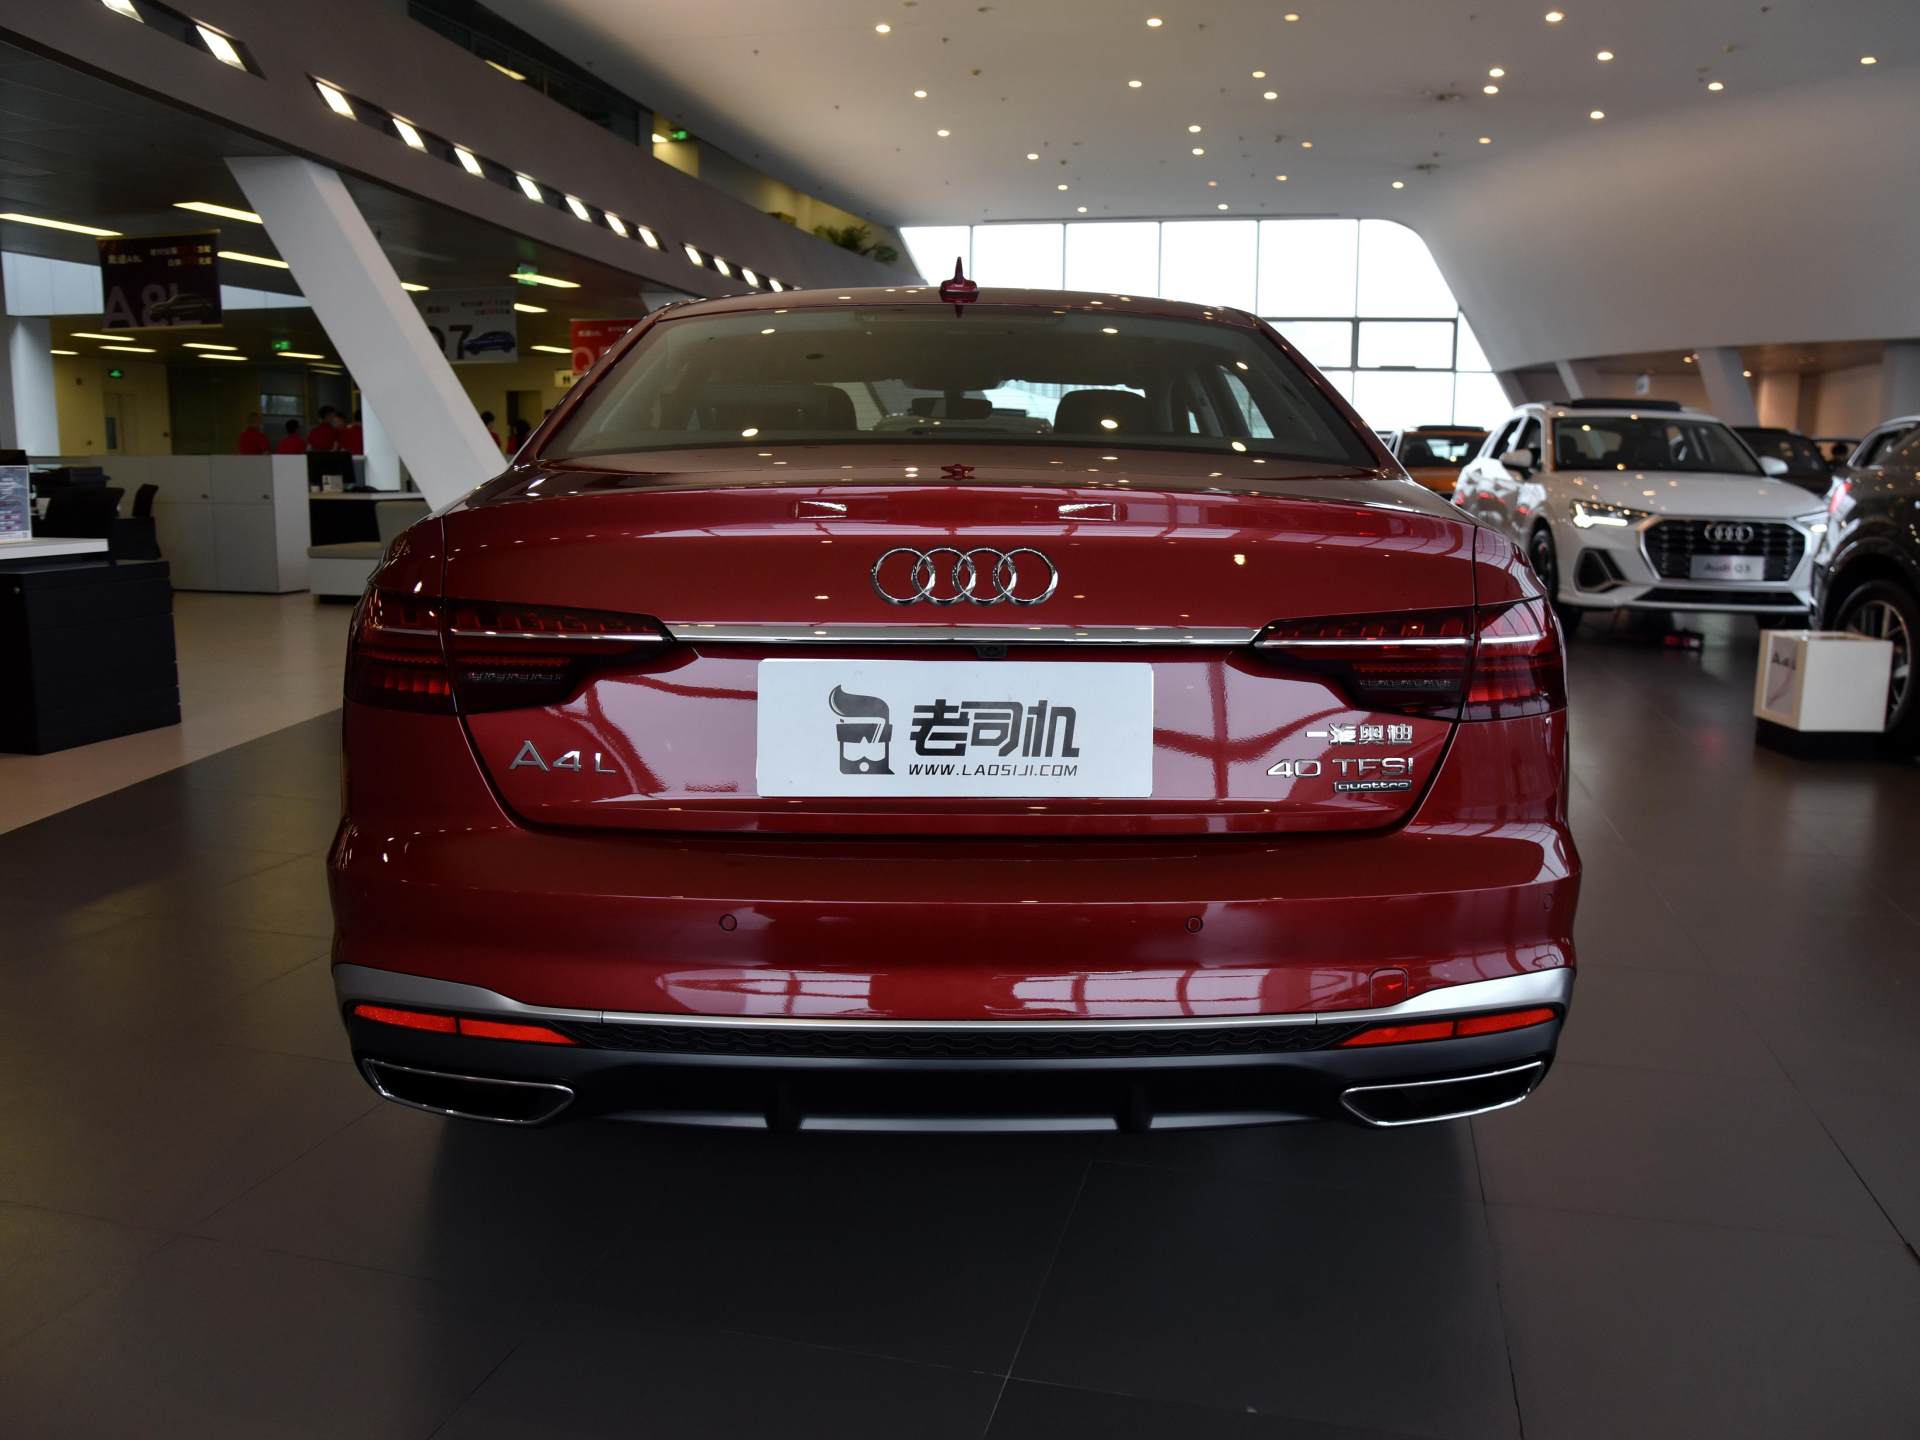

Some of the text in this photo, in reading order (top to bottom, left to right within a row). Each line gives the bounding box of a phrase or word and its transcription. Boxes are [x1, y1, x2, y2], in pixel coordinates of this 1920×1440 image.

[909, 698, 1080, 758] 老司机
[908, 763, 1078, 777] WWW.LAOSIJI.COM
[1266, 757, 1414, 778] 40 TFSI
[1336, 781, 1410, 792] quattro
